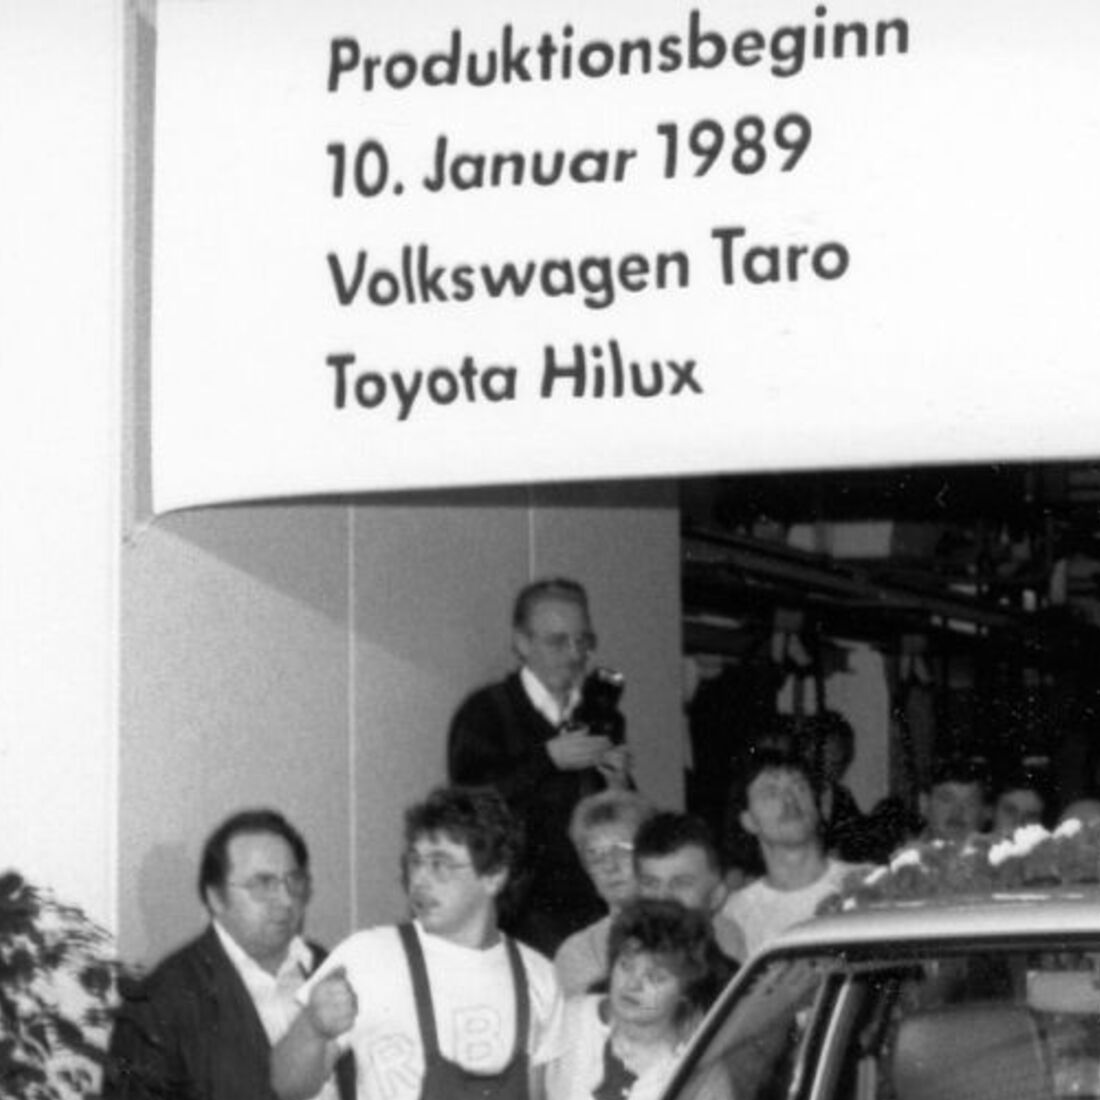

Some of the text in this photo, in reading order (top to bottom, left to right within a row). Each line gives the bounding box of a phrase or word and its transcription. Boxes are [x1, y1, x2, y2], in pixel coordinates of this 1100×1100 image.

[328, 5, 910, 92] Produktionsbeginn
[327, 112, 813, 198] 10. Januar 1989
[327, 227, 850, 310] Volkswagen Taro
[326, 340, 704, 421] Toyota Hilux
